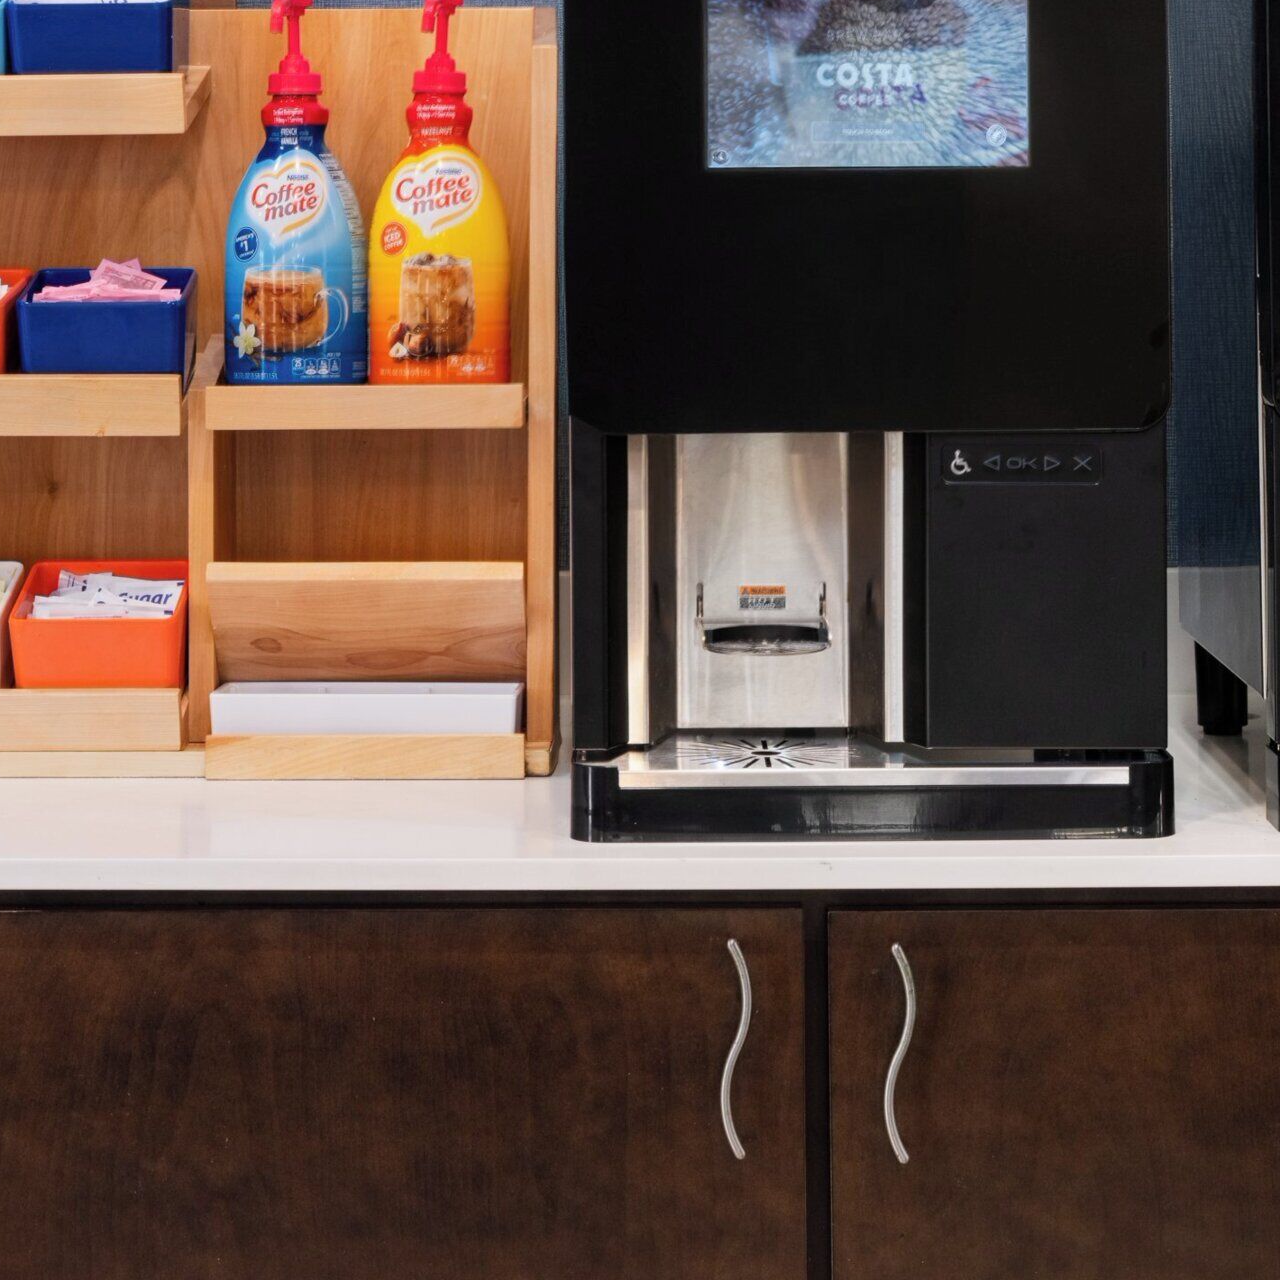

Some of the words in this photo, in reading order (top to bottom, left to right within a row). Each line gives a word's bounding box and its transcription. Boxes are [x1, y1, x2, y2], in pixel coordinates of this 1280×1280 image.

[816, 62, 913, 89] COSTA
[251, 182, 316, 208] Coffee
[395, 175, 470, 202] Coffee
[413, 188, 473, 215] mate
[264, 195, 319, 221] mate
[1006, 457, 1038, 470] OK
